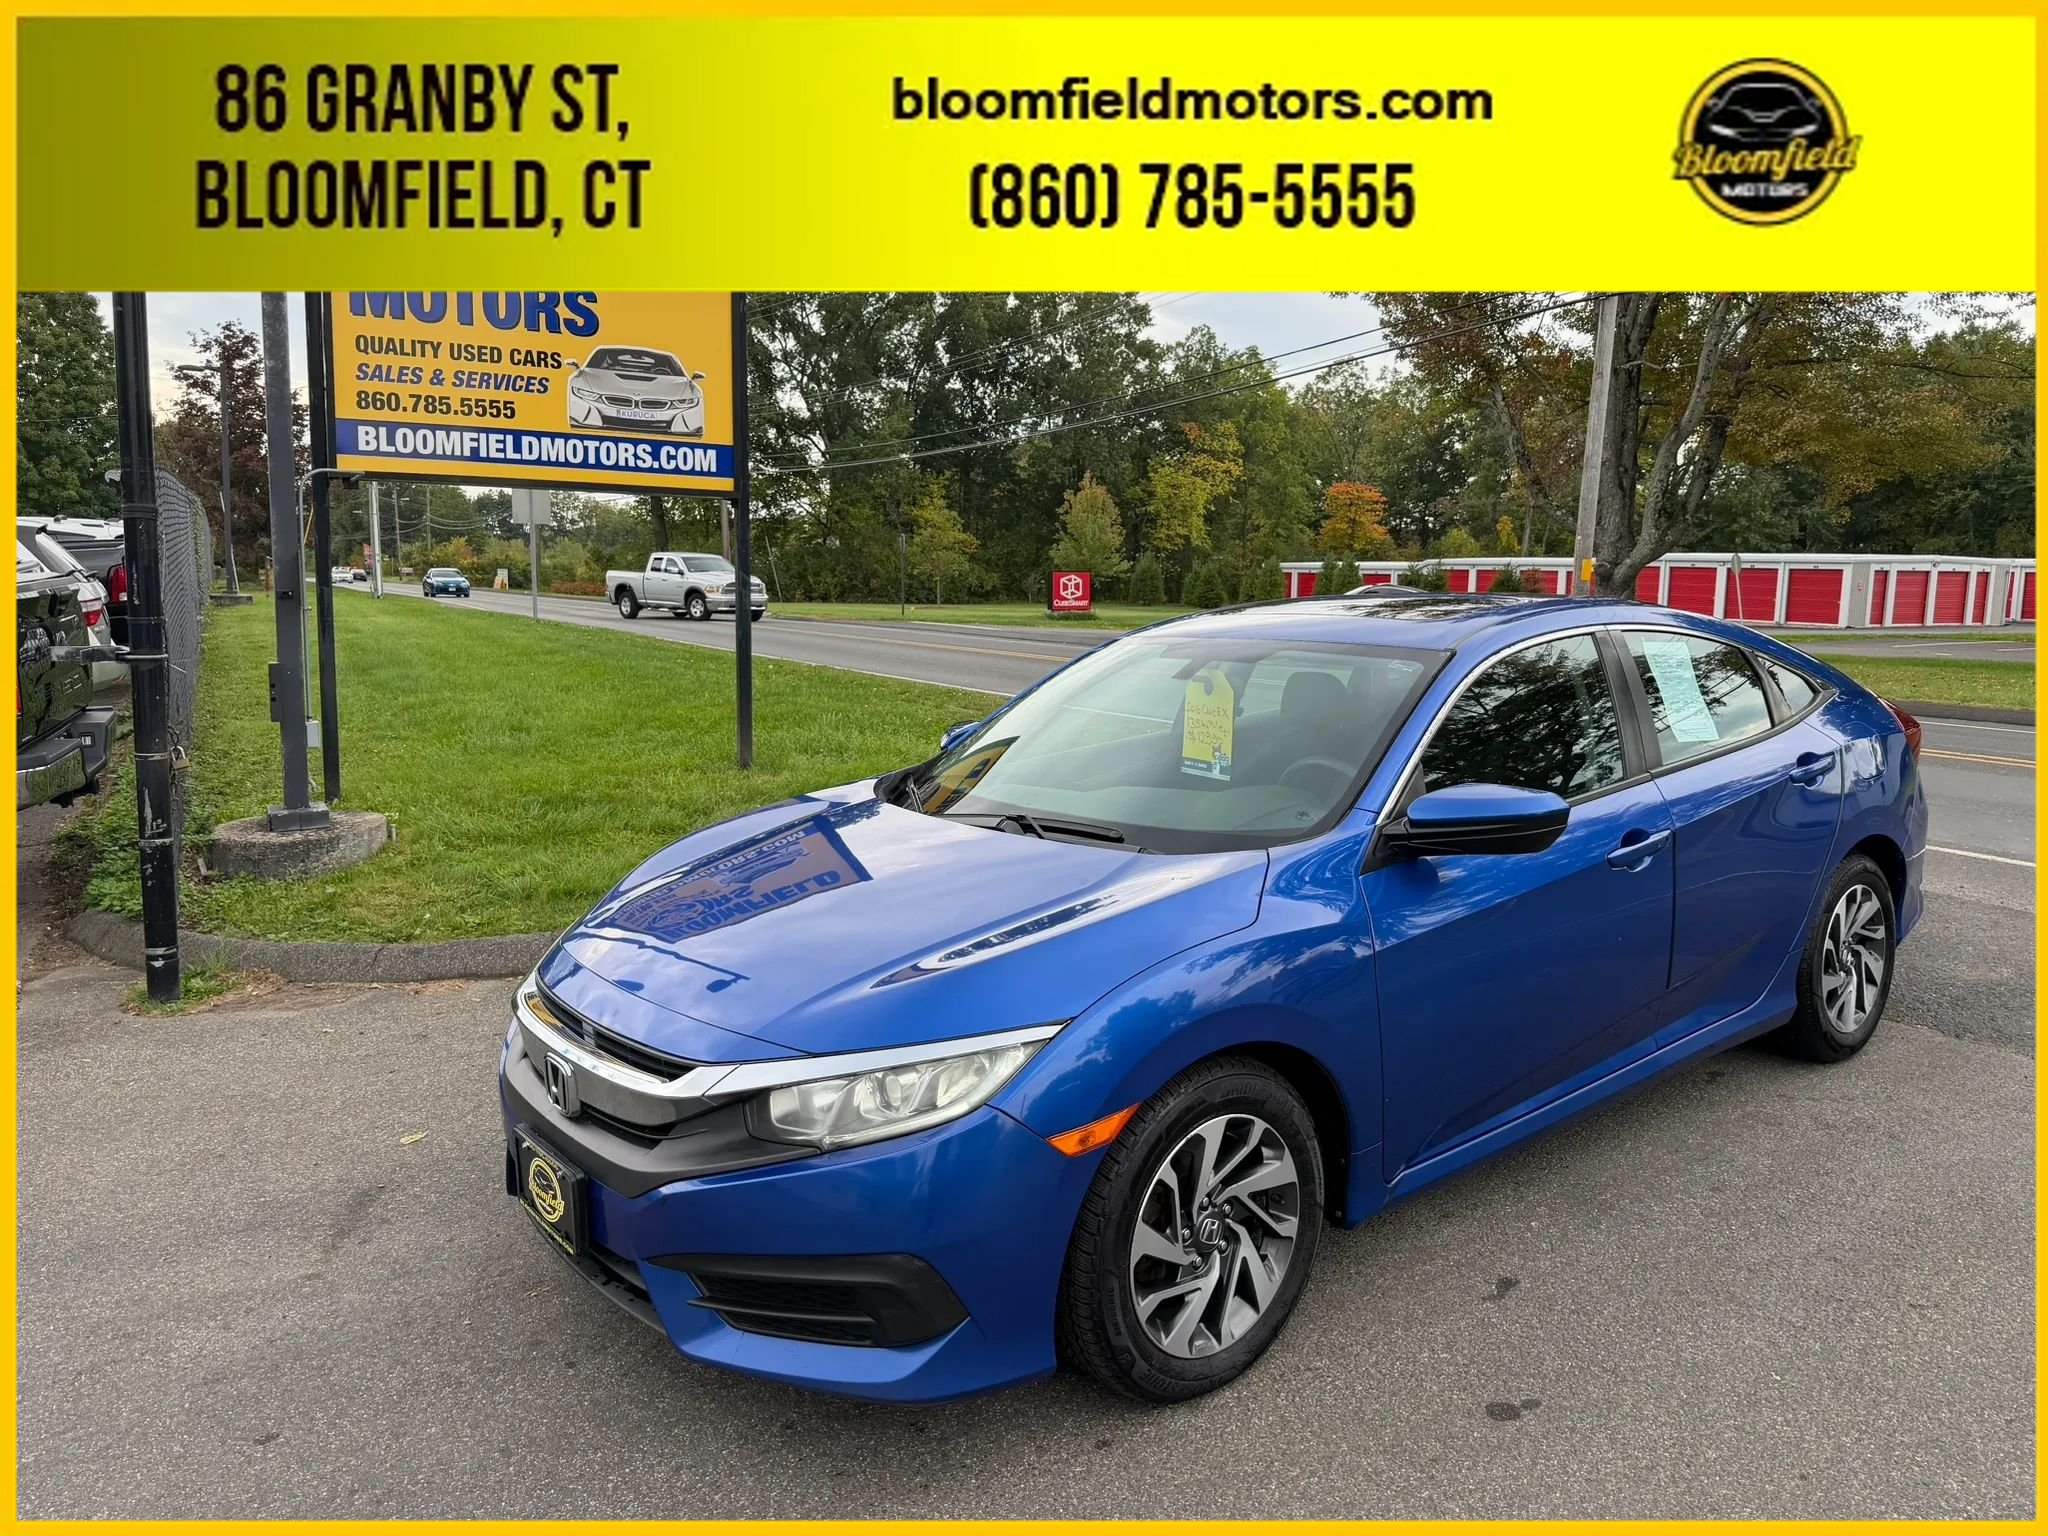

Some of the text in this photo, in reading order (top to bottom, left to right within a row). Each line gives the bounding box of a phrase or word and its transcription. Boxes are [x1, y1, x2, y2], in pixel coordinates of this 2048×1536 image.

[355, 334, 563, 370] QUALITY USED CARS
[355, 362, 550, 395] SALES & SERVICES
[356, 390, 516, 420] 860.785.5555
[621, 409, 656, 420] KURUCA
[357, 425, 717, 473] BLOOMFIELDMOTORS.COM
